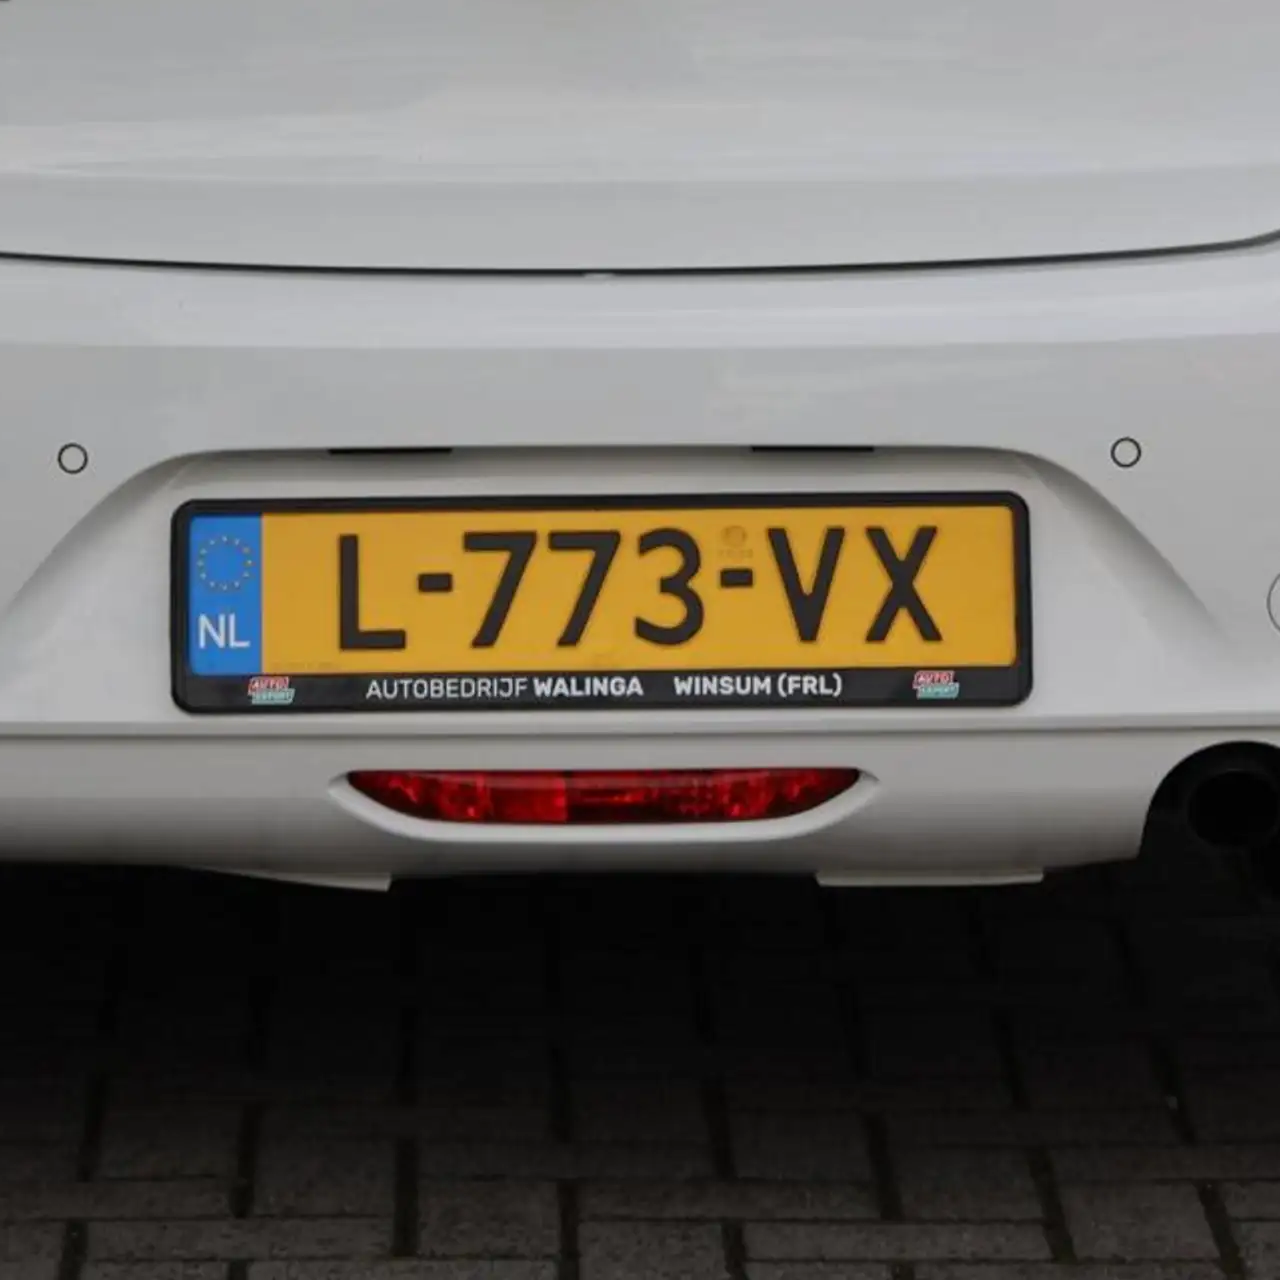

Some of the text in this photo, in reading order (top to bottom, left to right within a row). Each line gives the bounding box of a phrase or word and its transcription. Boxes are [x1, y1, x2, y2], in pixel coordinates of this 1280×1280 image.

[339, 526, 944, 651] L-773-VX
[198, 613, 251, 649] NL
[366, 672, 843, 699] AUTOBEDRIJF WALINGA WINSUM (FRL)
